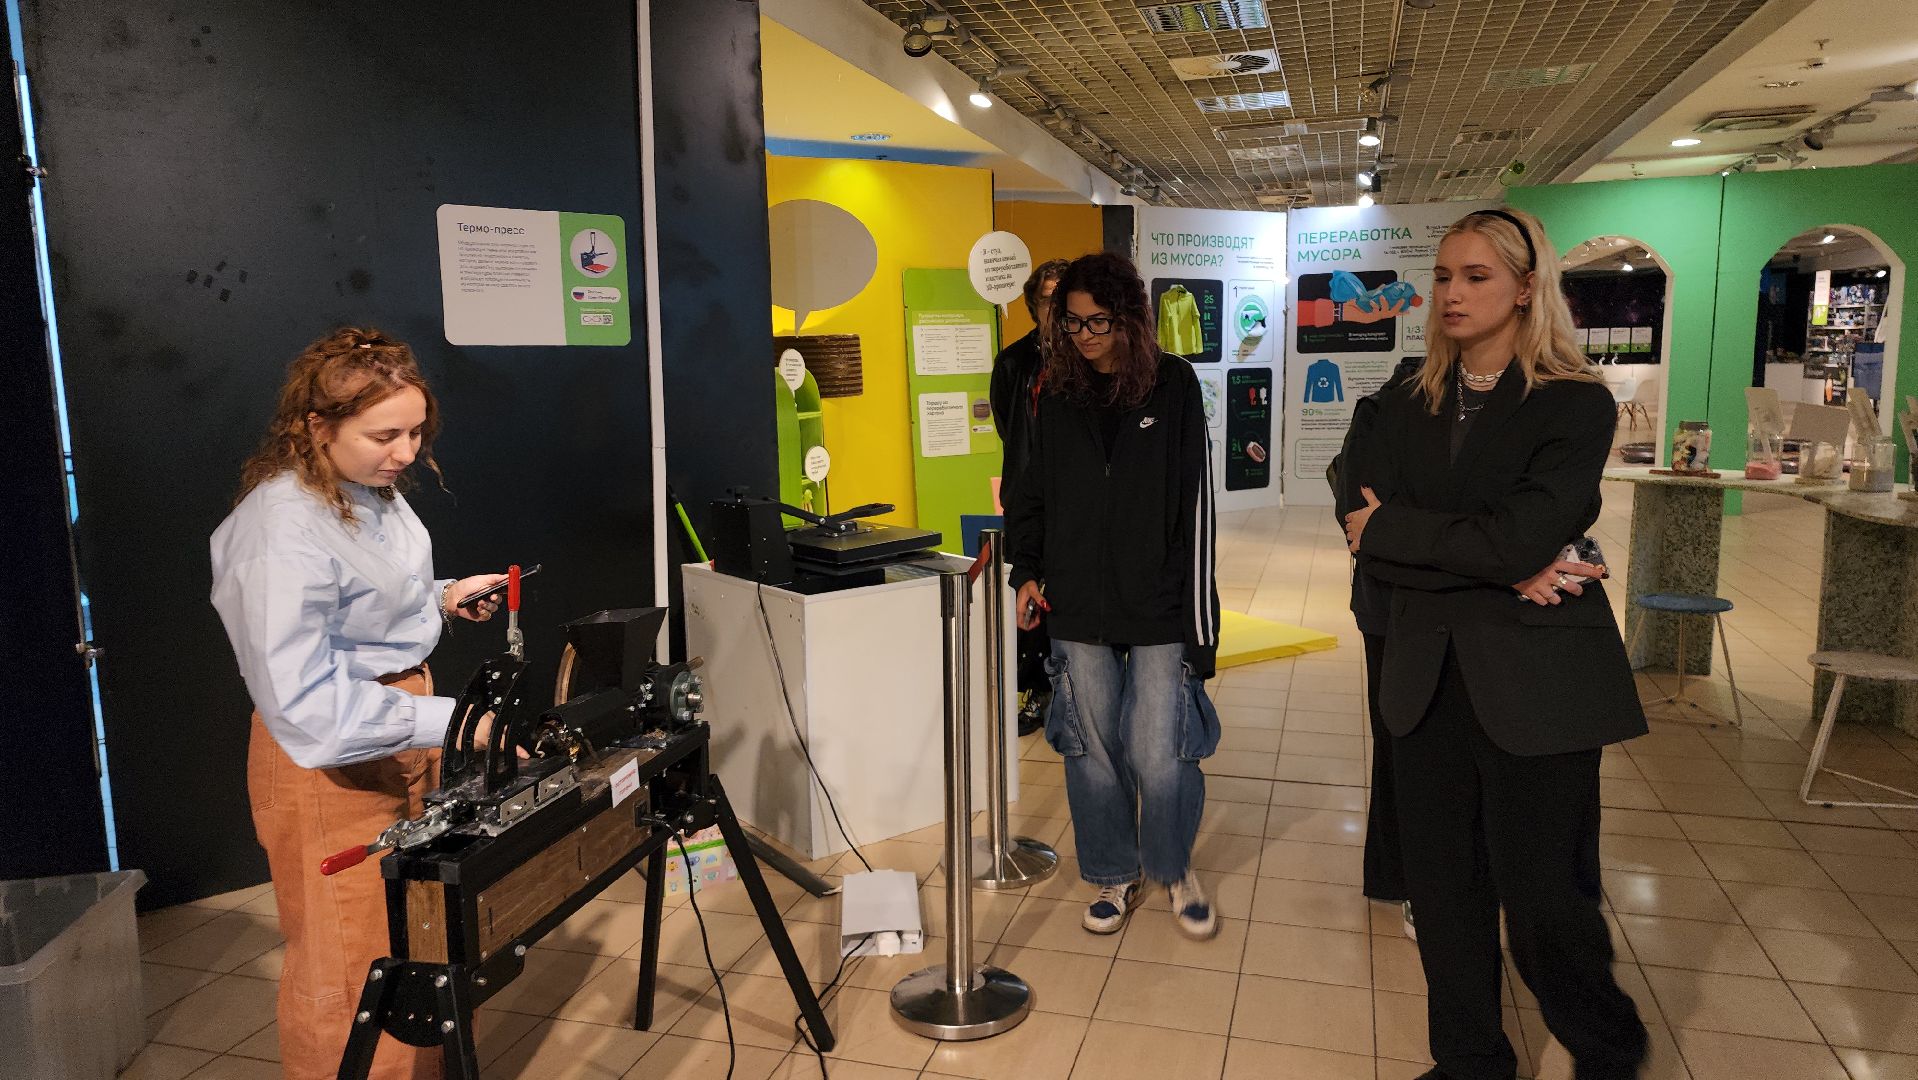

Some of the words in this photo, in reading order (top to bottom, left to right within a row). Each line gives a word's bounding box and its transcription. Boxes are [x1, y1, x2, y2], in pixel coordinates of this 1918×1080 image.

[457, 222, 525, 237] Термо-пресс
[1298, 227, 1413, 245] ПЕРЕРАБОТКА
[1151, 232, 1174, 246] ЧТО
[1177, 233, 1255, 251] ПРОИЗВОДЯТ
[1151, 252, 1167, 265] ИЗ
[1170, 253, 1224, 267] МУСОРА?
[1297, 248, 1362, 262] МУСОРА
[1204, 294, 1214, 304] 25
